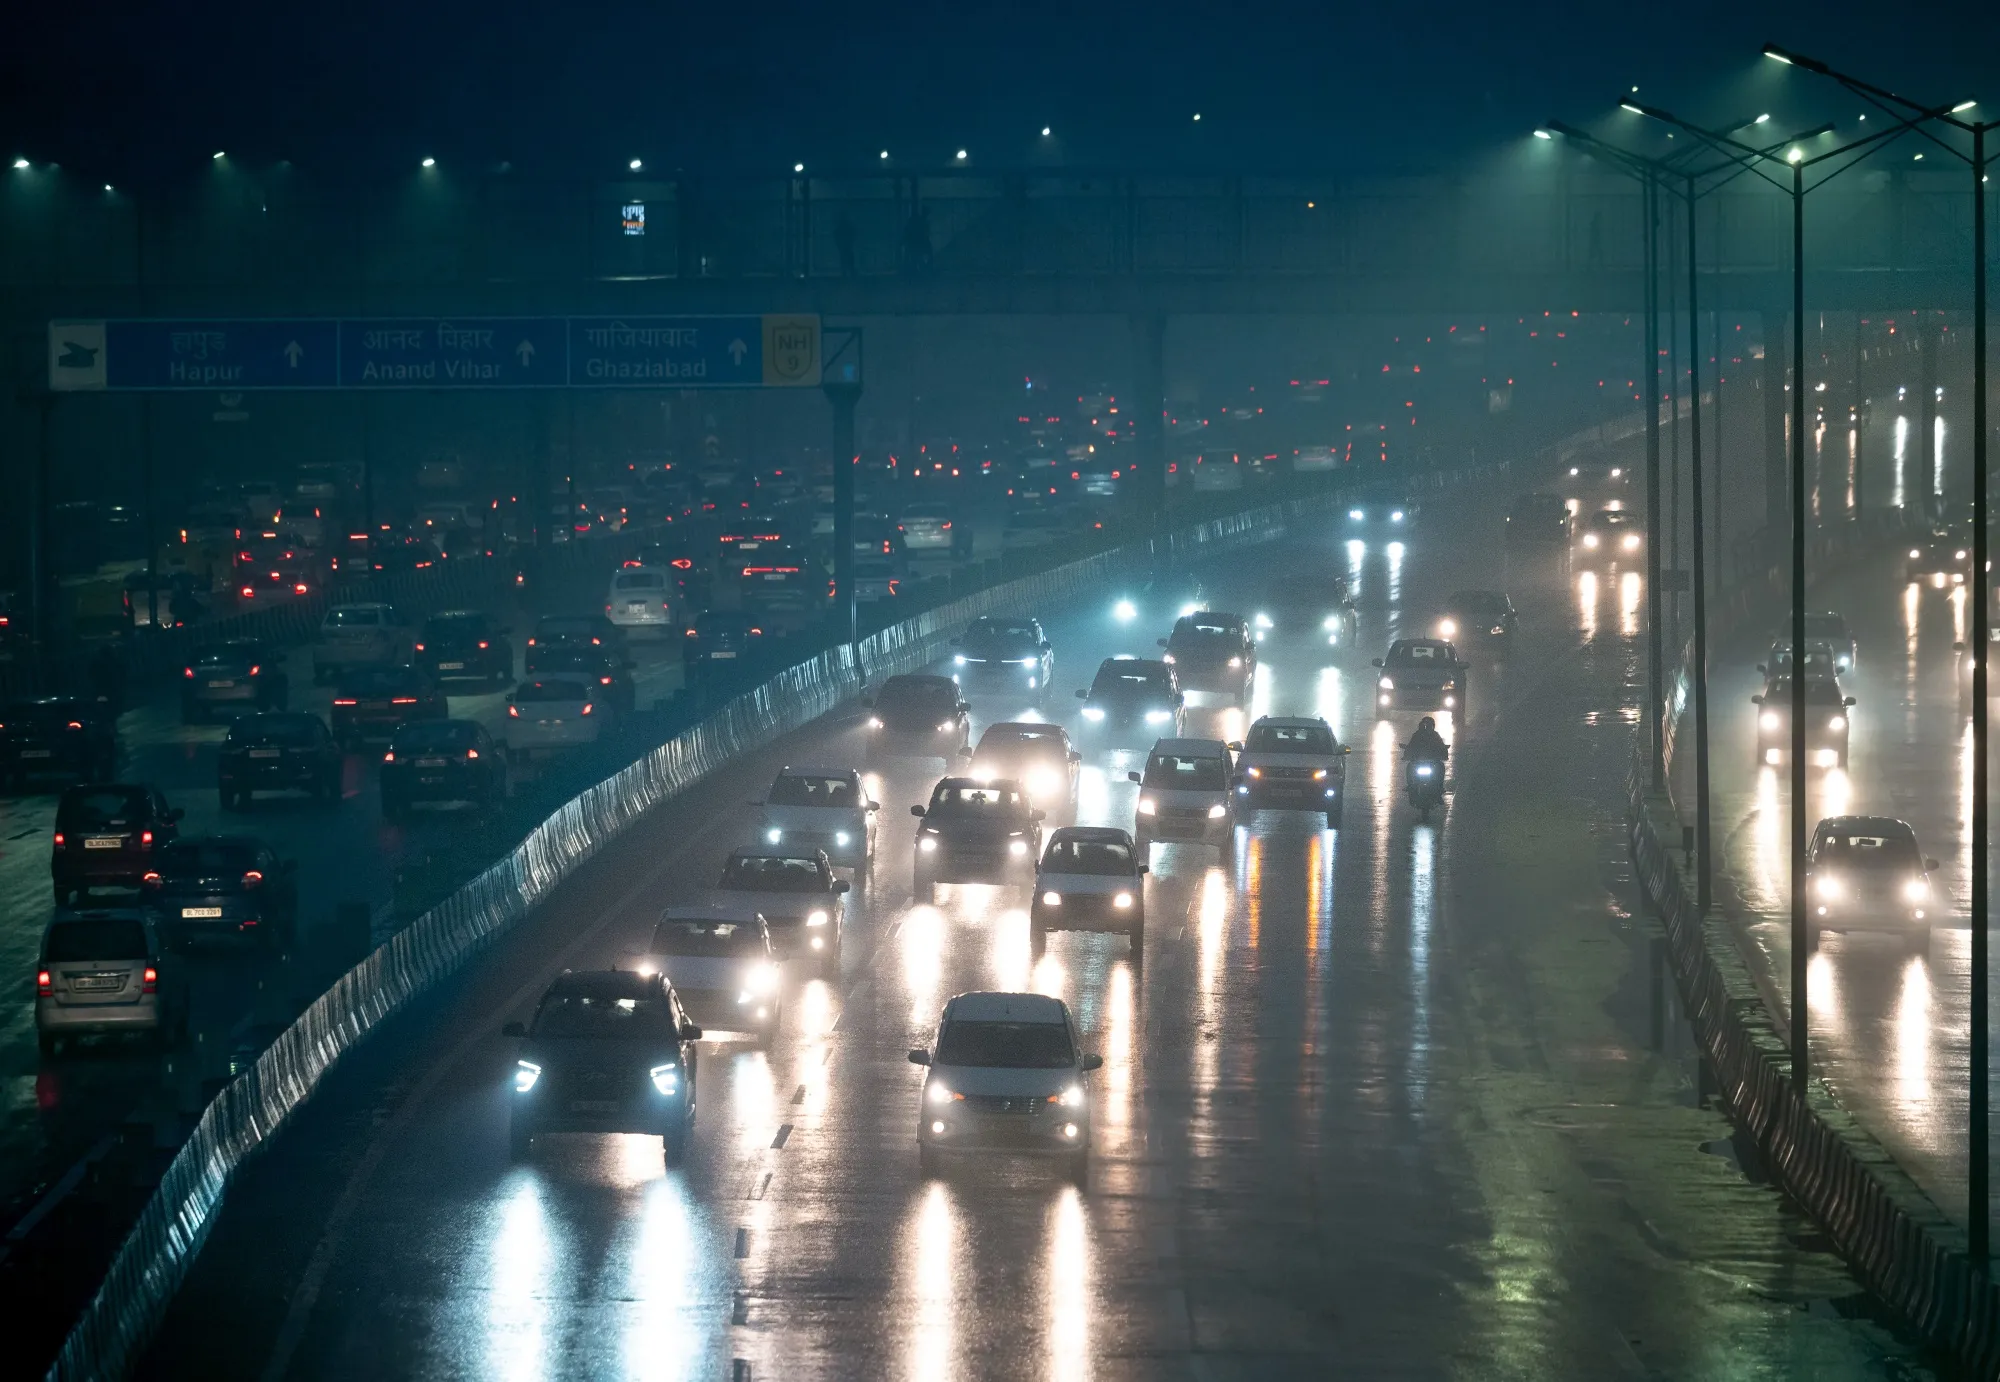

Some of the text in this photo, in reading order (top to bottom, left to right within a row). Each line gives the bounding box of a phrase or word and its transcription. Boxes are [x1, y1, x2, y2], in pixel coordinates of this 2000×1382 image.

[436, 321, 495, 353] विहार
[778, 334, 807, 351] NH
[170, 361, 244, 384] Hapur
[362, 358, 502, 380] Anand Vihar
[585, 357, 707, 378] Ghaziabad
[787, 356, 800, 372] 9
